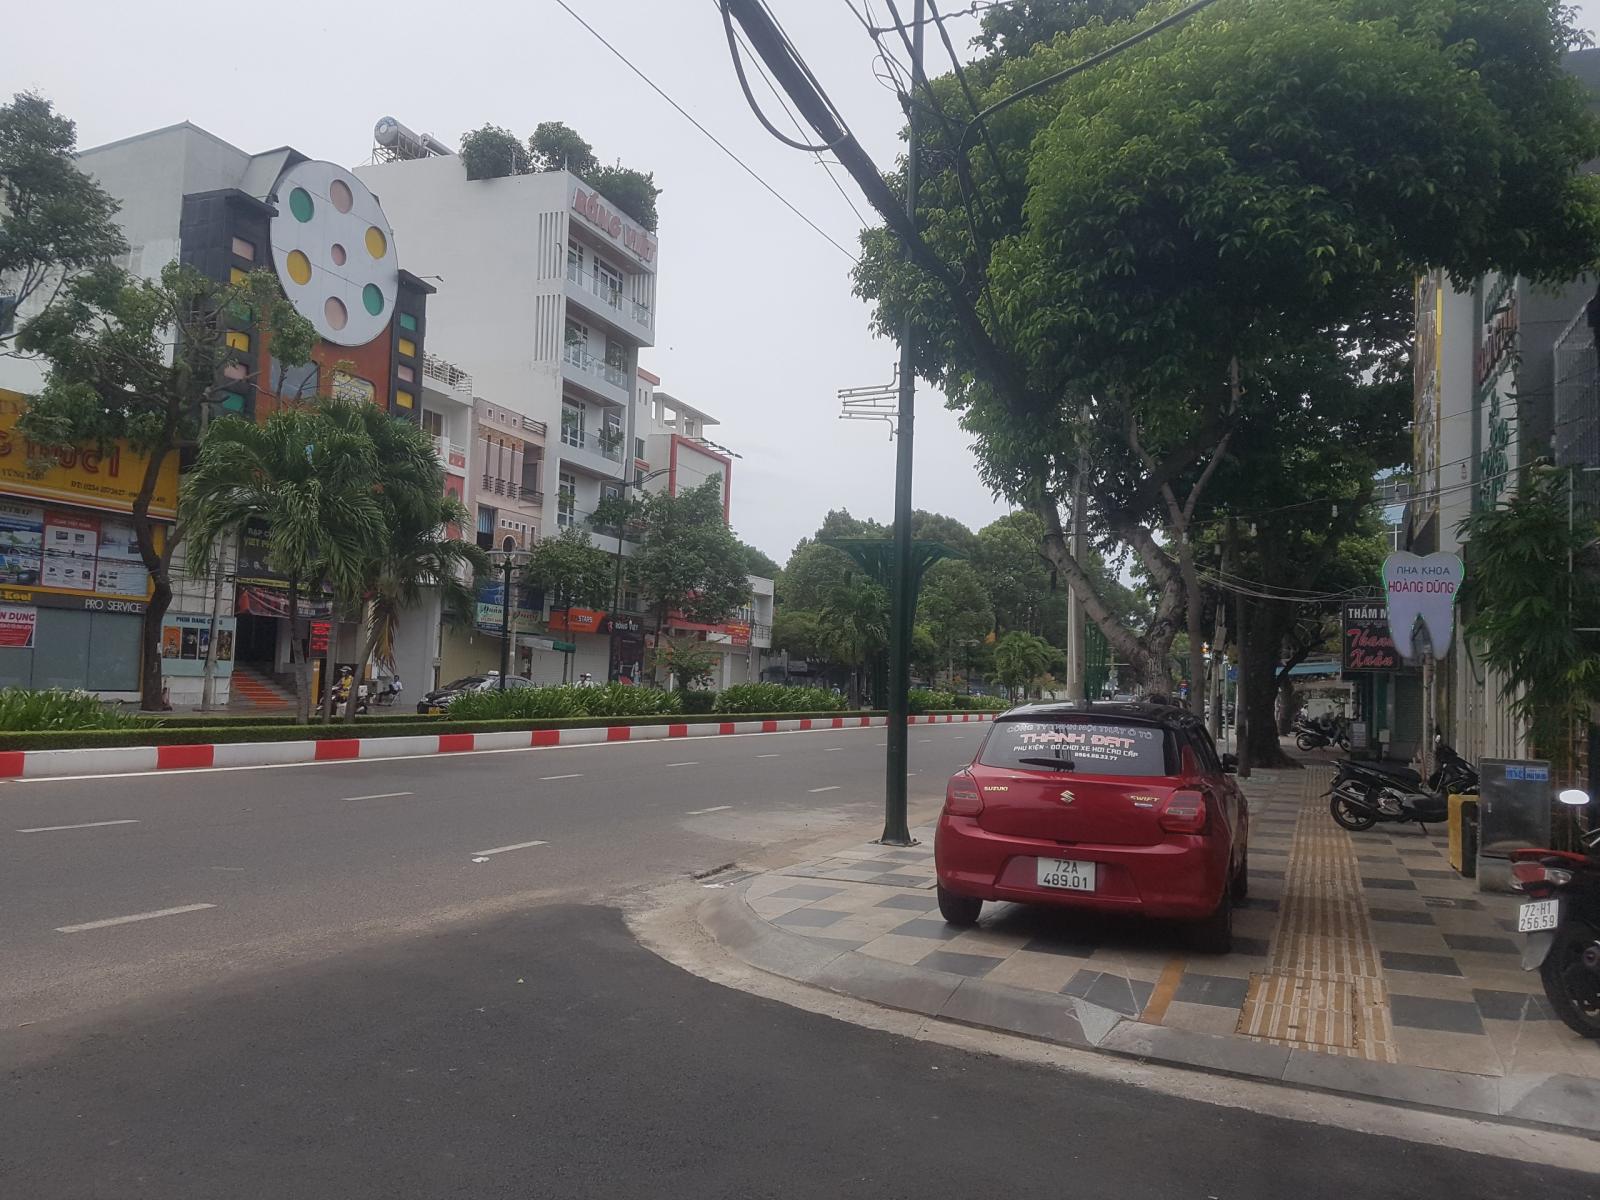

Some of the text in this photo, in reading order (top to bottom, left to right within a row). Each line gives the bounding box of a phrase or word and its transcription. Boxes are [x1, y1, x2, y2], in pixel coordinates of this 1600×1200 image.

[1421, 566, 1451, 576] KHOA
[1388, 578, 1455, 594] HOÀNG DŨNG
[84, 598, 142, 613] PRO SERVICE
[1036, 723, 1049, 731] TY
[1020, 730, 1135, 749] THÀNH ĐẠT
[1054, 859, 1079, 875] 72A
[1043, 872, 1088, 889] 489.01
[1525, 902, 1552, 918] 72-H1
[1520, 914, 1556, 931] 256.59
